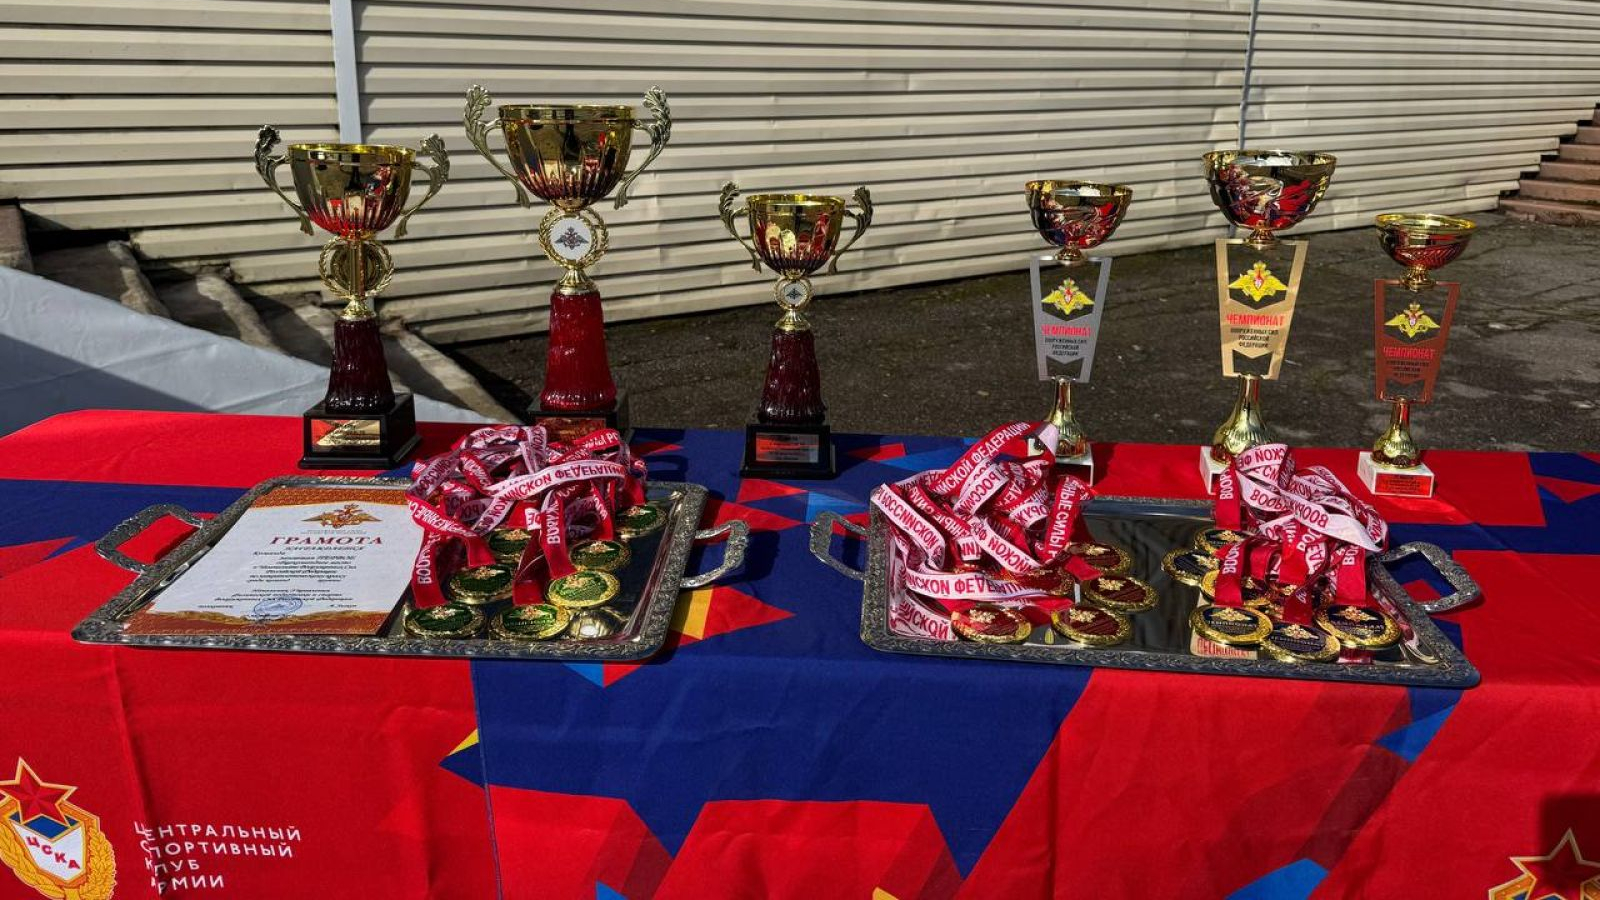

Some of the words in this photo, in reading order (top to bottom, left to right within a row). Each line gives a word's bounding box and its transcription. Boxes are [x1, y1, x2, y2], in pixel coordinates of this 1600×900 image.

[1226, 313, 1284, 327] ЧЕМПИОНАТ
[1041, 324, 1092, 337] ЧЕМПИОНАТ
[1383, 346, 1436, 360] ЧЕМПИОНАТ
[269, 535, 383, 546] ГРАМОТА
[133, 820, 302, 842] ЦЕНТРАЛЬНЫЙ
[25, 835, 81, 870] ЦСКА
[139, 839, 294, 859] СПОРТИВНЫЙ
